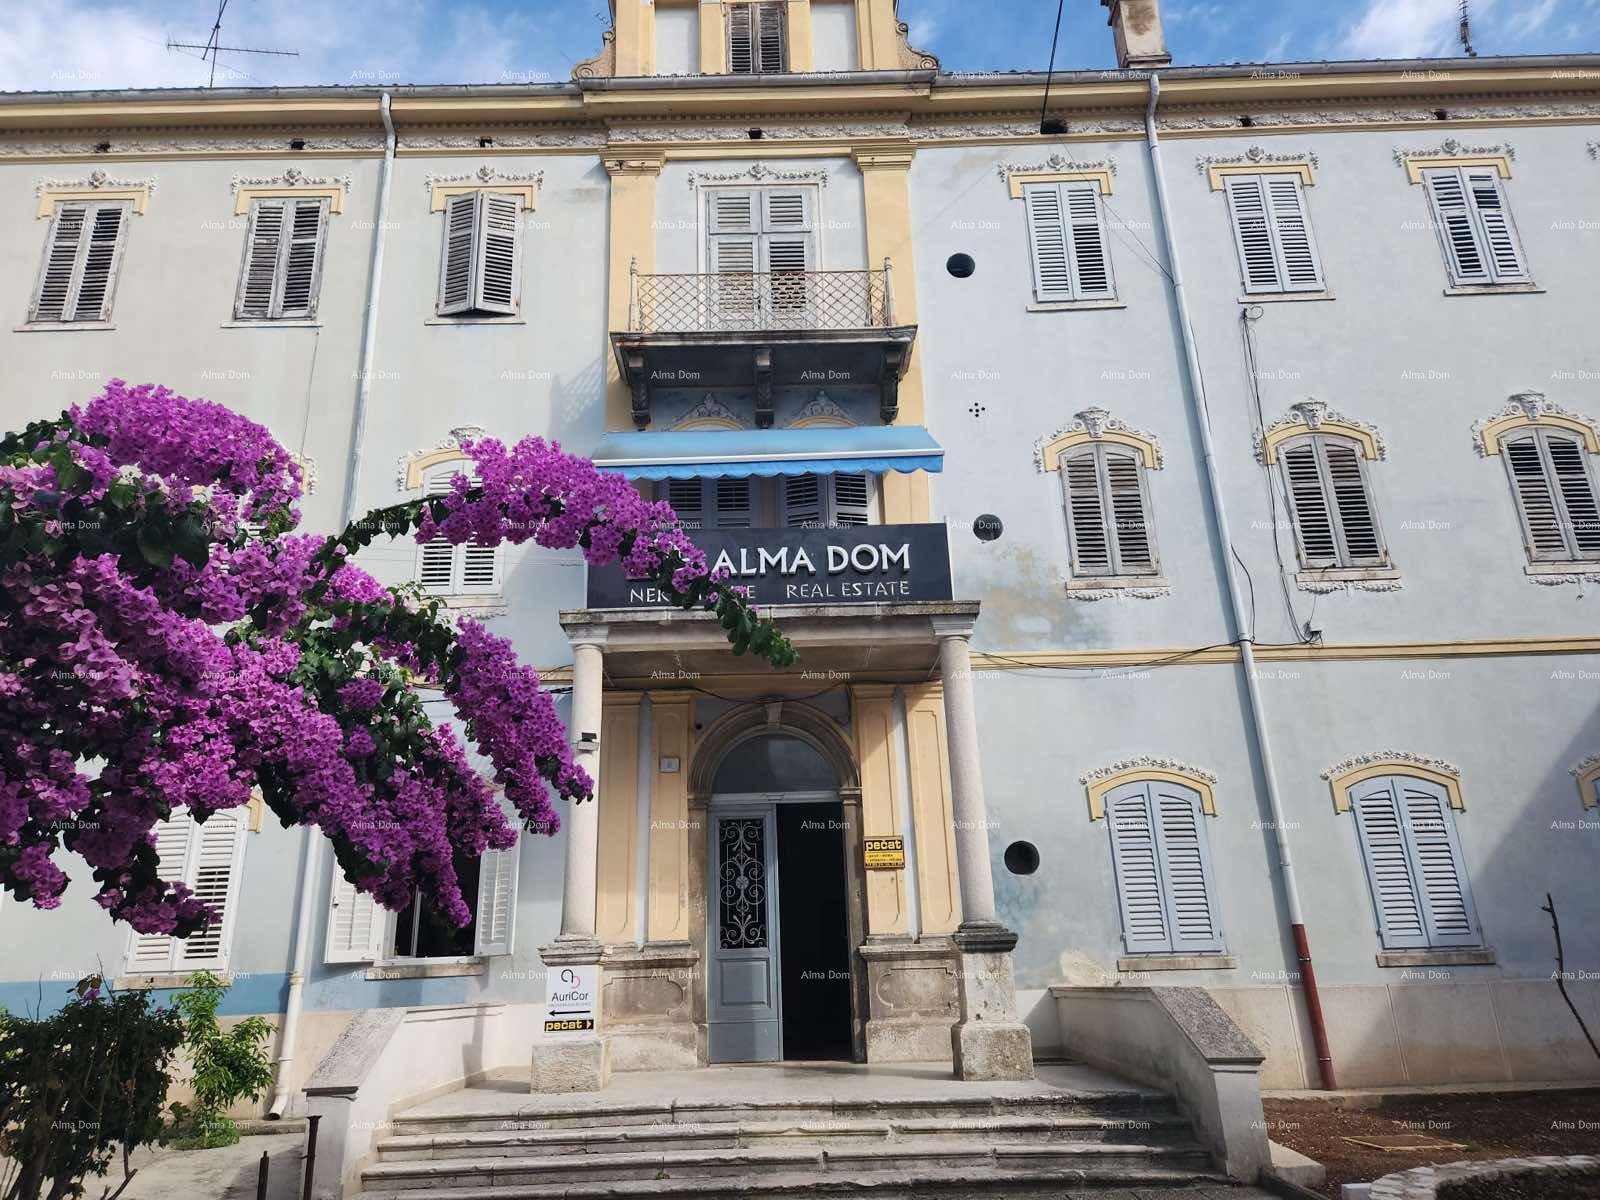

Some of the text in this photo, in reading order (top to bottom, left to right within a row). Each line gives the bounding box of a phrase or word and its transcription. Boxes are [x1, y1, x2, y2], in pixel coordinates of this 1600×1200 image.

[711, 543, 911, 577] ALMA DOM
[786, 580, 911, 599] REAL ESTATE
[551, 991, 589, 1001] AuriCor
